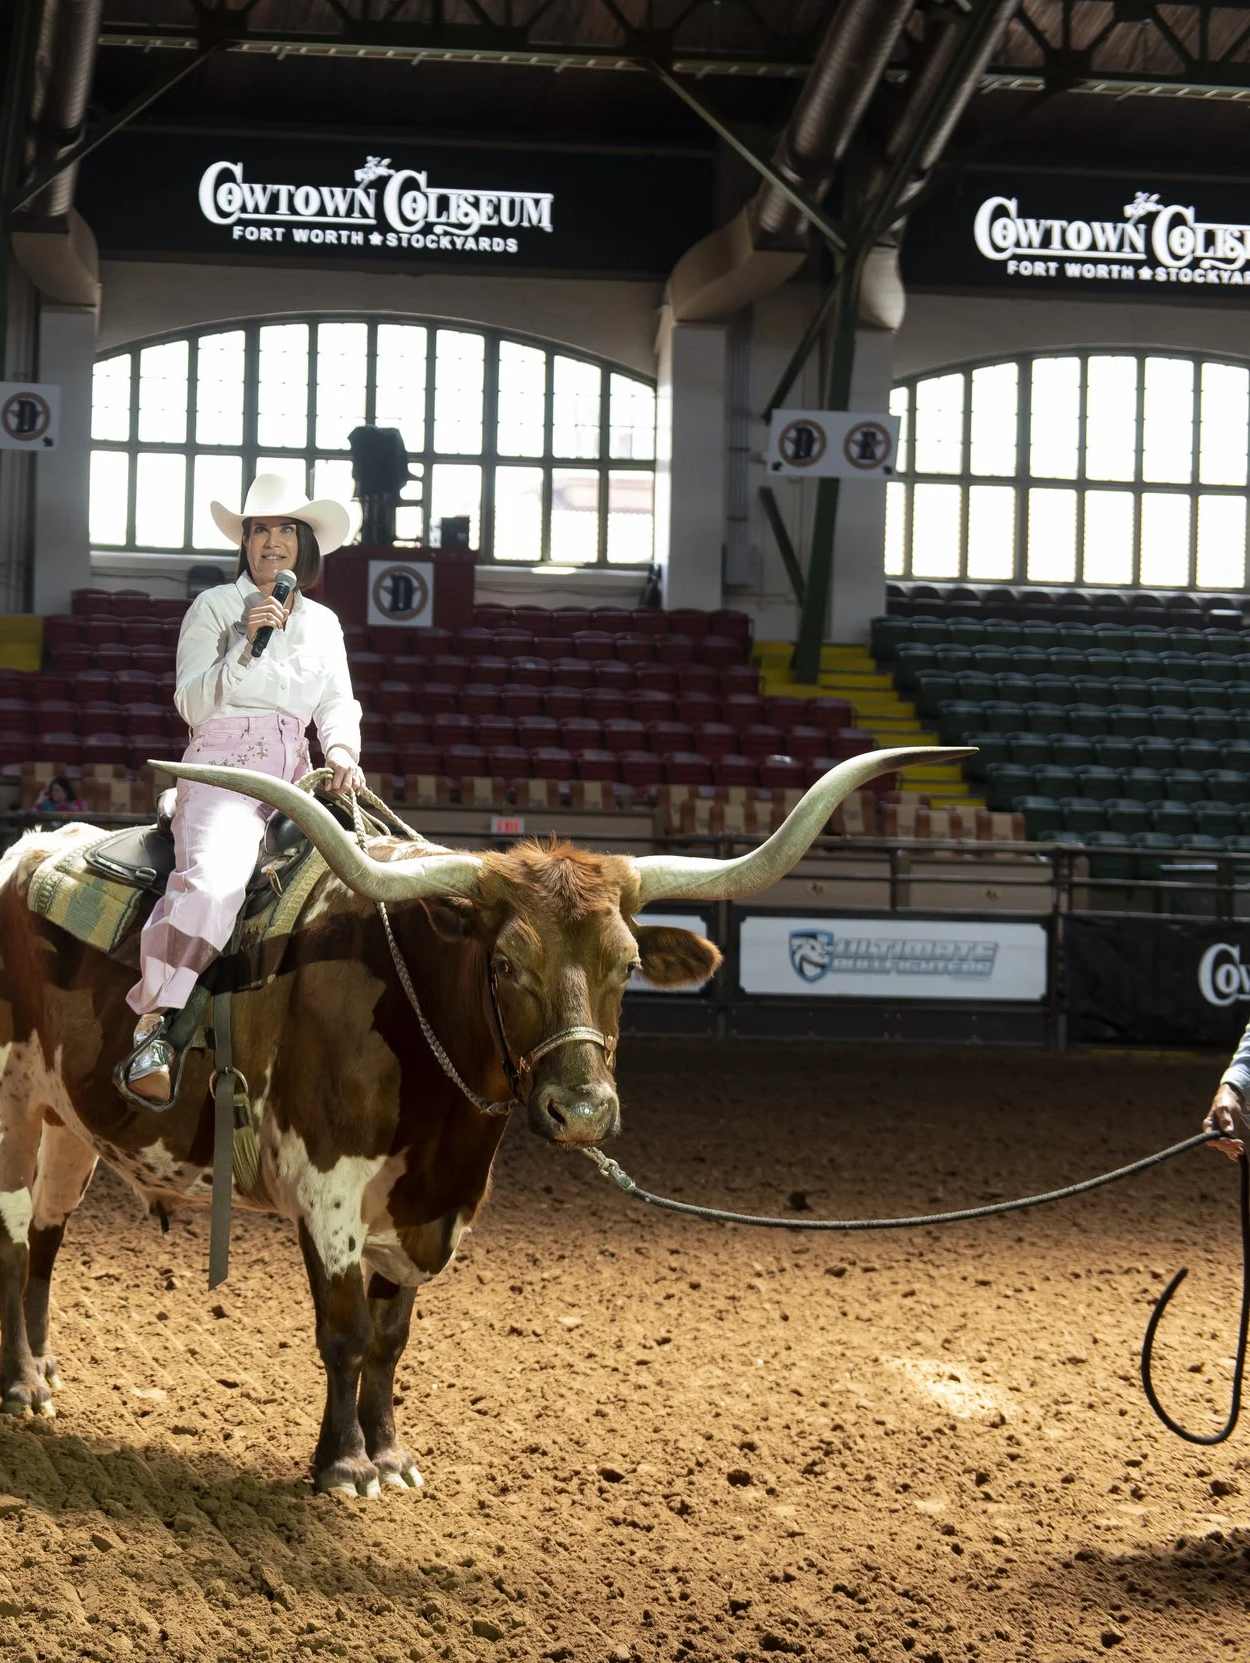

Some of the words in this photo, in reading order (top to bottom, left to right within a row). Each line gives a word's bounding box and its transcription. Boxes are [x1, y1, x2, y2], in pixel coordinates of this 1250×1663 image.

[199, 160, 377, 226] COWTOWN
[384, 170, 554, 236] COLISEUM
[232, 225, 286, 242] FORT
[292, 228, 364, 246] WORTH
[385, 232, 519, 253] STOCKYARDS
[973, 196, 1148, 261] COWTOWN
[1007, 260, 1060, 277] FORT
[1065, 263, 1135, 281] WORTH
[14, 399, 38, 434] D
[792, 426, 816, 460] D
[389, 573, 415, 611] D
[1197, 942, 1250, 1007] CO
